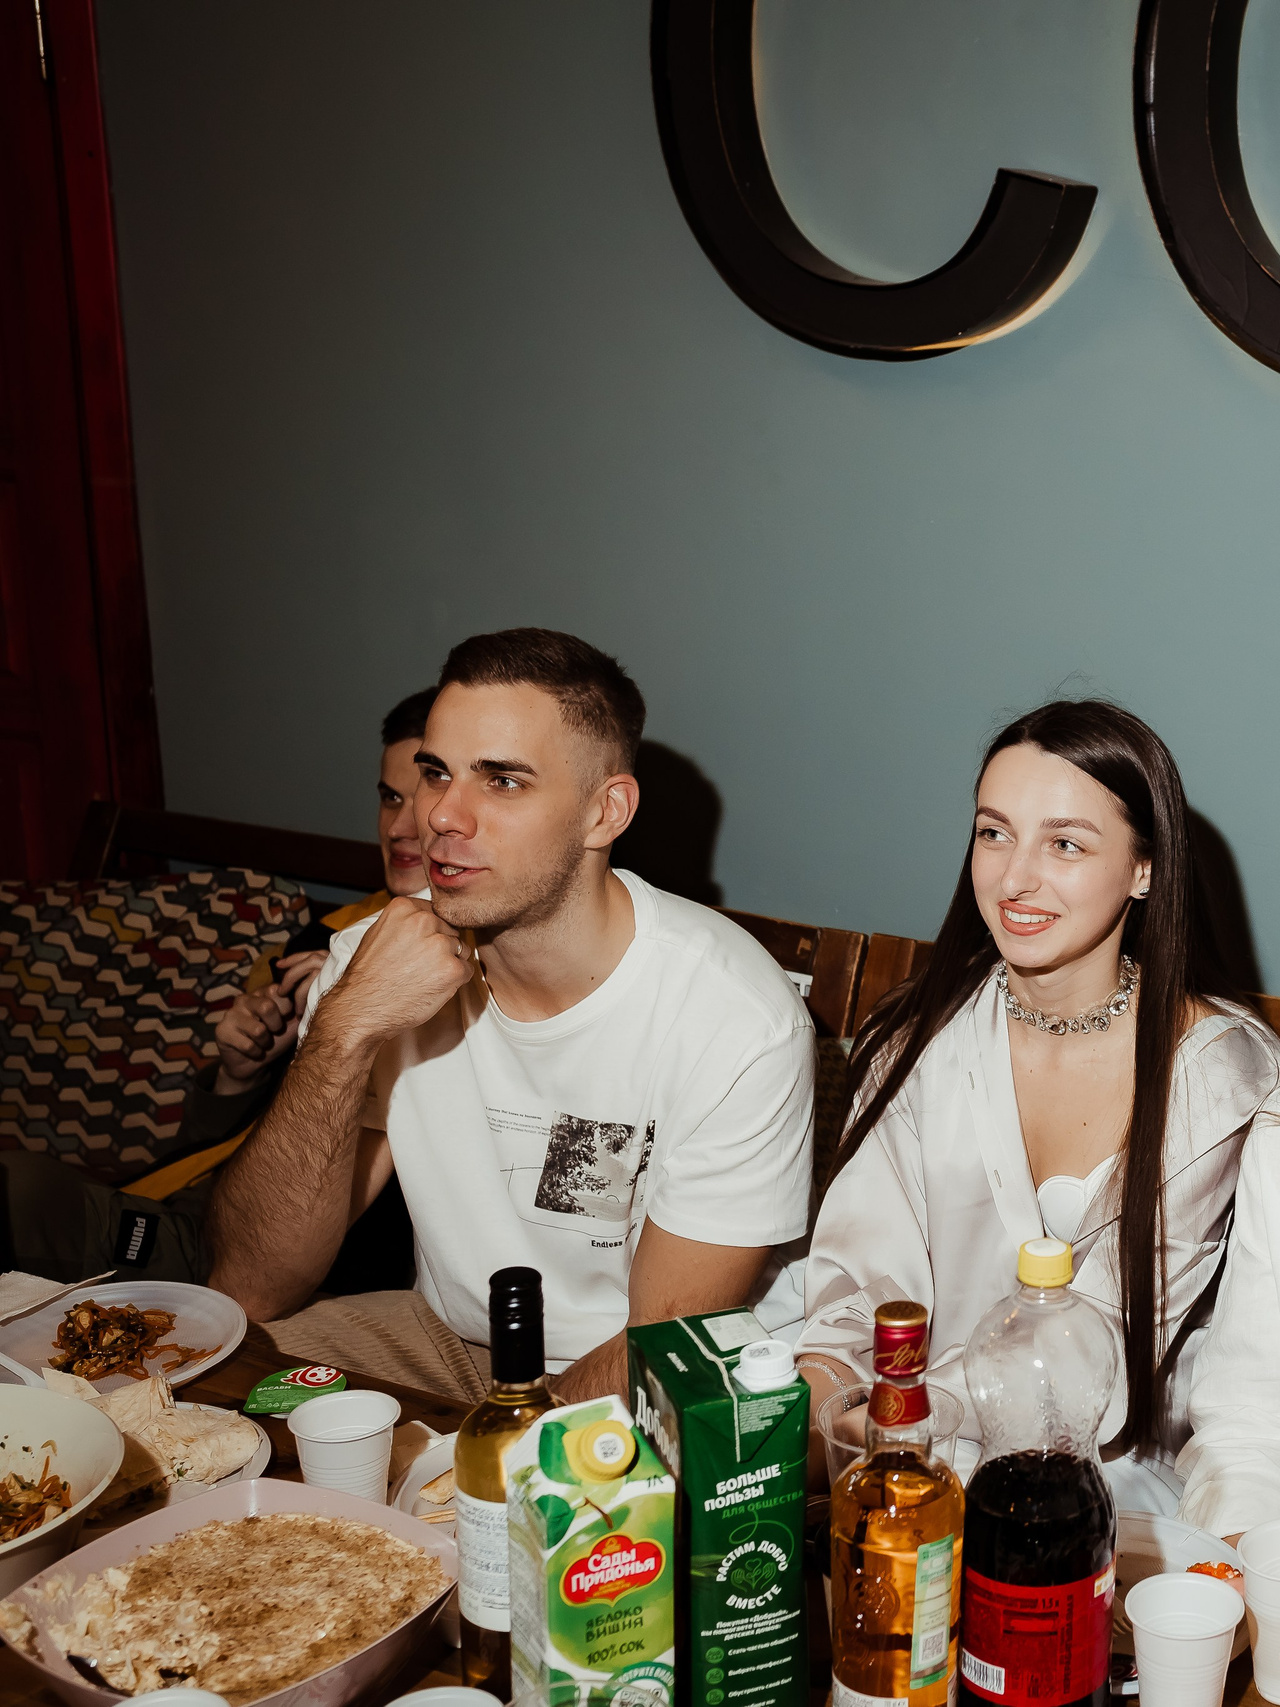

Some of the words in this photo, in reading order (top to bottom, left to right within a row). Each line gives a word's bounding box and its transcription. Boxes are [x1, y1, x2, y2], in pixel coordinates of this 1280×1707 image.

[126, 1217, 146, 1260] PUMA
[591, 1240, 623, 1248] Endless
[715, 1463, 782, 1496] БОЛЬШЕ
[703, 1483, 765, 1512] ПОЛЬЗЫ
[722, 1504, 746, 1520] ДЛЯ
[747, 1489, 804, 1512] ОБЩЕСТВА
[588, 1548, 636, 1572] Сады
[716, 1541, 756, 1582] РАСТИМ
[757, 1540, 789, 1572] ДОБРО
[571, 1557, 655, 1593] Придонья
[725, 1583, 782, 1610] ВМЕСТЕ
[585, 1616, 643, 1643] ВИШНЯ
[586, 1606, 643, 1630] ЯБЛОКО
[586, 1644, 617, 1665] 100%
[619, 1639, 645, 1655] СОК
